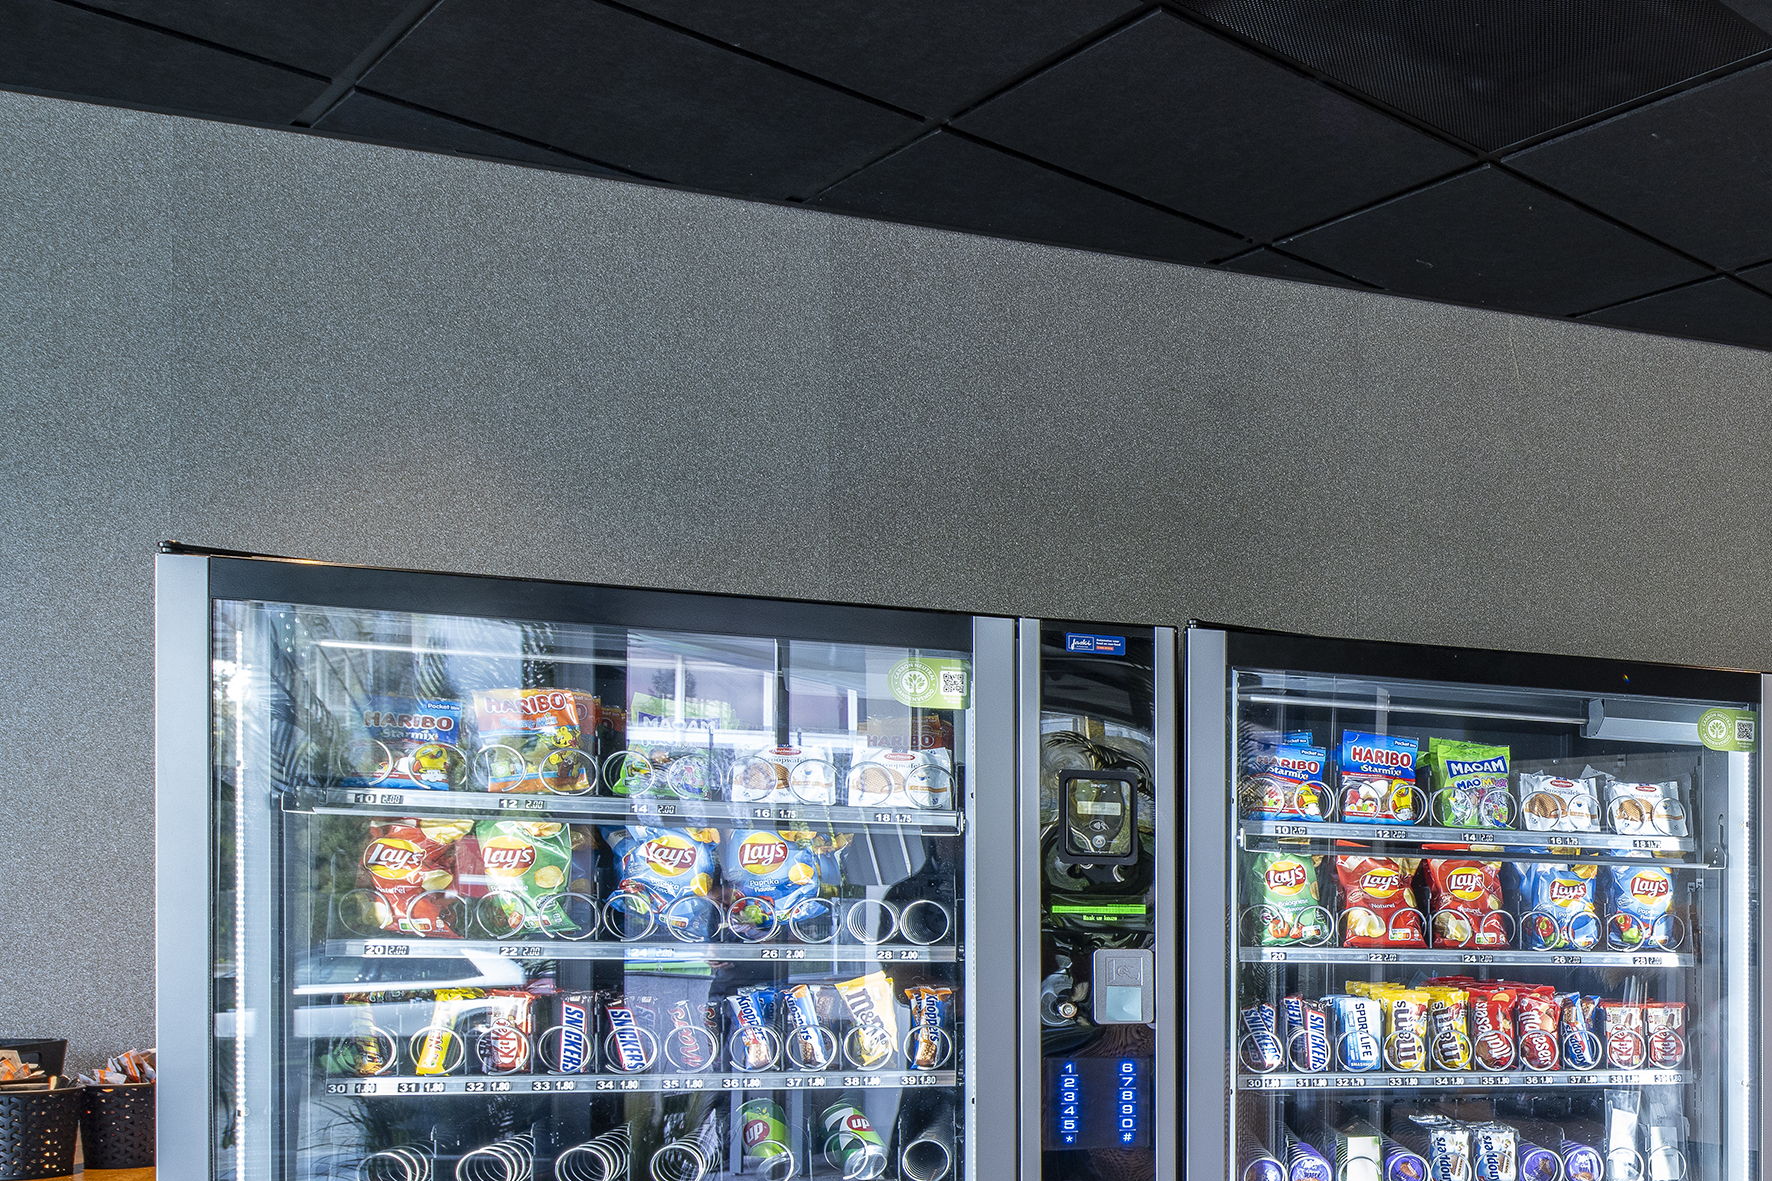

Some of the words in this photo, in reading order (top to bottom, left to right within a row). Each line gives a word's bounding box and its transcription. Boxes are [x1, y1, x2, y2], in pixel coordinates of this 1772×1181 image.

[485, 692, 566, 715] HARIBO
[364, 711, 454, 731] HARIBO
[381, 728, 438, 742] Starmix
[1352, 746, 1412, 769] HARIBO
[1362, 764, 1400, 776] Starmix
[1450, 758, 1506, 775] MAOAM
[357, 794, 374, 803] 10
[501, 800, 517, 809] 12
[525, 800, 543, 809] 2.00
[755, 809, 771, 818] 16
[779, 809, 796, 818] 1.75
[876, 813, 891, 823] 18
[896, 814, 912, 823] 1.75
[368, 844, 424, 870] Lay's
[483, 846, 533, 870] Lay's
[647, 841, 694, 871] Lay's
[740, 841, 786, 866] Lay's
[1268, 866, 1305, 887] Lay's
[749, 878, 780, 889] Paprika
[1363, 873, 1398, 892] Lay's
[1450, 873, 1483, 893] Lay's
[1633, 879, 1667, 897] Lay's
[1553, 883, 1586, 900] Lay's
[365, 946, 384, 955] 20
[762, 950, 778, 958] 26
[786, 950, 803, 958] 2.00
[736, 995, 767, 1041] Knoppers
[561, 1005, 586, 1073] SNICKERS
[609, 1009, 645, 1071] SNICKERS
[1309, 1012, 1327, 1070] SNICKERS
[1065, 1064, 1072, 1073] 1
[1122, 1063, 1133, 1073] 6
[533, 1082, 549, 1090] 33
[556, 1081, 574, 1090] 1.80
[901, 1076, 917, 1085] 39
[920, 1076, 936, 1085] 1.80
[1064, 1078, 1075, 1087] 2
[1122, 1077, 1133, 1086] 7
[399, 1084, 416, 1092] 31
[424, 1083, 443, 1092] 1.80
[1064, 1092, 1075, 1101] 3
[1122, 1091, 1133, 1100] 8
[1064, 1106, 1075, 1115] 4
[1122, 1105, 1133, 1114] 9
[1064, 1120, 1075, 1129] 5
[1122, 1118, 1133, 1128] 0
